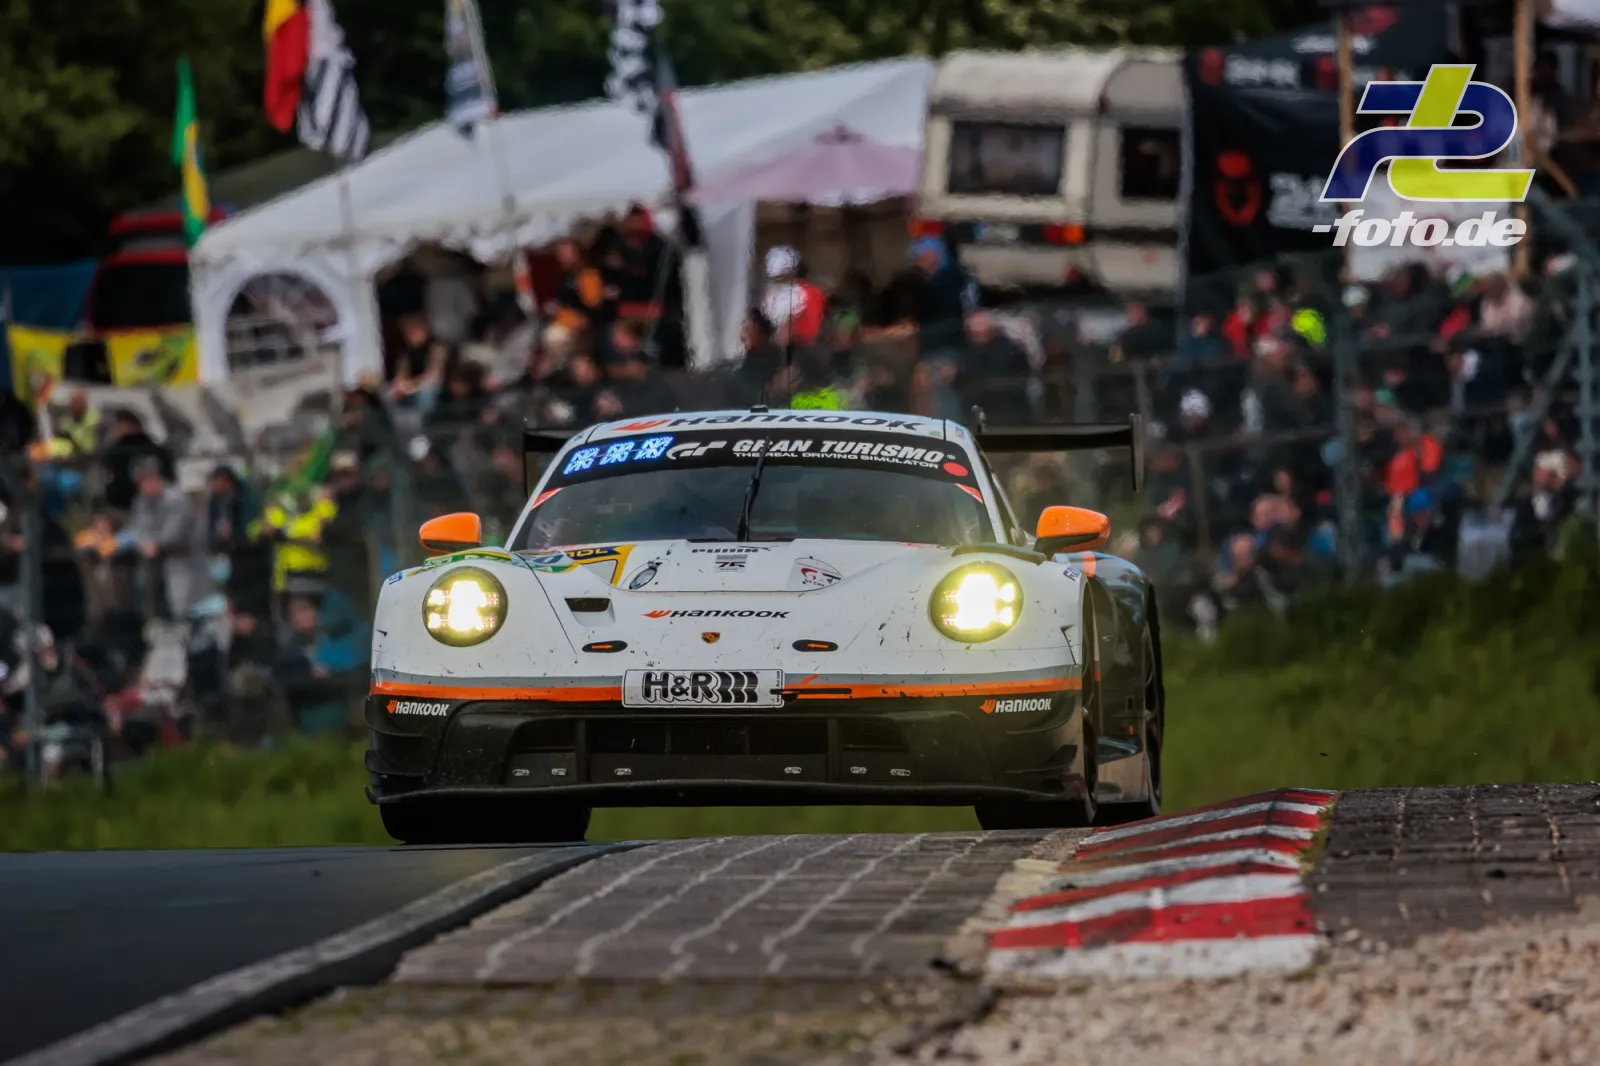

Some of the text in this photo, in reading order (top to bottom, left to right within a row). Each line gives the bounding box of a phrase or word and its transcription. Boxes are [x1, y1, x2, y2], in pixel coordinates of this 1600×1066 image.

[732, 439, 945, 463] GRAN TURISMO
[802, 452, 859, 460] DRIVING
[860, 455, 939, 469] SIMULATOR
[642, 671, 719, 704] H&R
